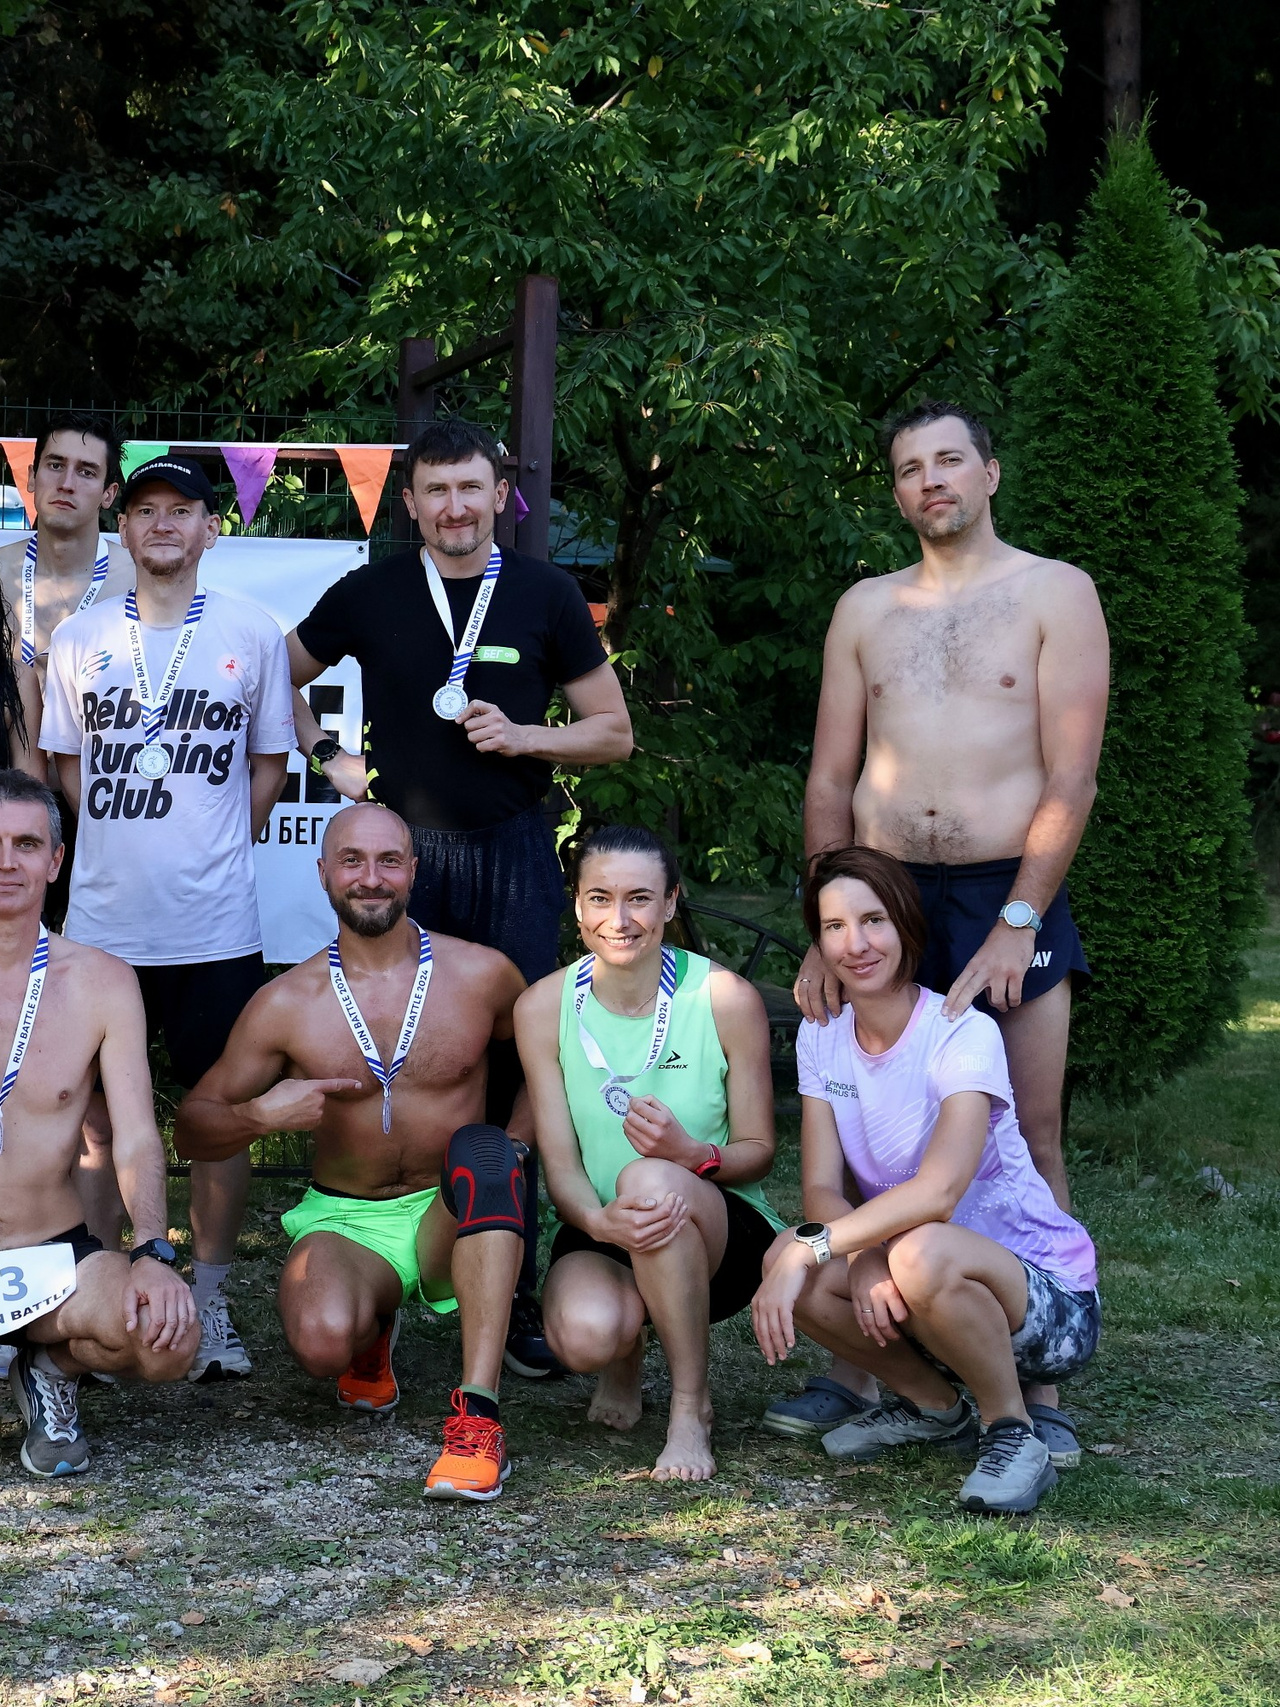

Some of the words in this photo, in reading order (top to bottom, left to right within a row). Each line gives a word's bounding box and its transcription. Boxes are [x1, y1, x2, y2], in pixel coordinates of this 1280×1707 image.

[25, 564, 33, 583] 2024
[25, 584, 33, 614] BATTLE
[84, 587, 97, 606] 2024
[24, 616, 32, 635] RUN
[464, 630, 476, 648] RUN
[472, 604, 486, 630] BATTLE
[480, 585, 491, 603] 2024
[129, 625, 139, 645] 2024
[133, 646, 145, 678] BATTLE
[160, 683, 172, 701] RUN
[168, 650, 185, 682] BATTLE
[180, 629, 192, 650] 2024
[483, 649, 503, 659] БЕГ
[140, 679, 149, 699] RUN
[87, 778, 173, 820] Club
[278, 816, 333, 845] БЕГ
[1028, 950, 1053, 968] AY
[334, 972, 347, 994] 2024
[13, 1041, 25, 1063] RUN
[20, 1002, 35, 1039] BATTLE
[30, 978, 41, 1001] 2024
[342, 995, 362, 1029] BATTLE
[400, 1030, 412, 1051] RUN
[407, 993, 422, 1028] BATTLE
[417, 970, 428, 992] 2024
[357, 1030, 372, 1051] RUN
[650, 1027, 664, 1060] BATTLE
[658, 1001, 668, 1025] 2024
[0, 1265, 28, 1302] 3
